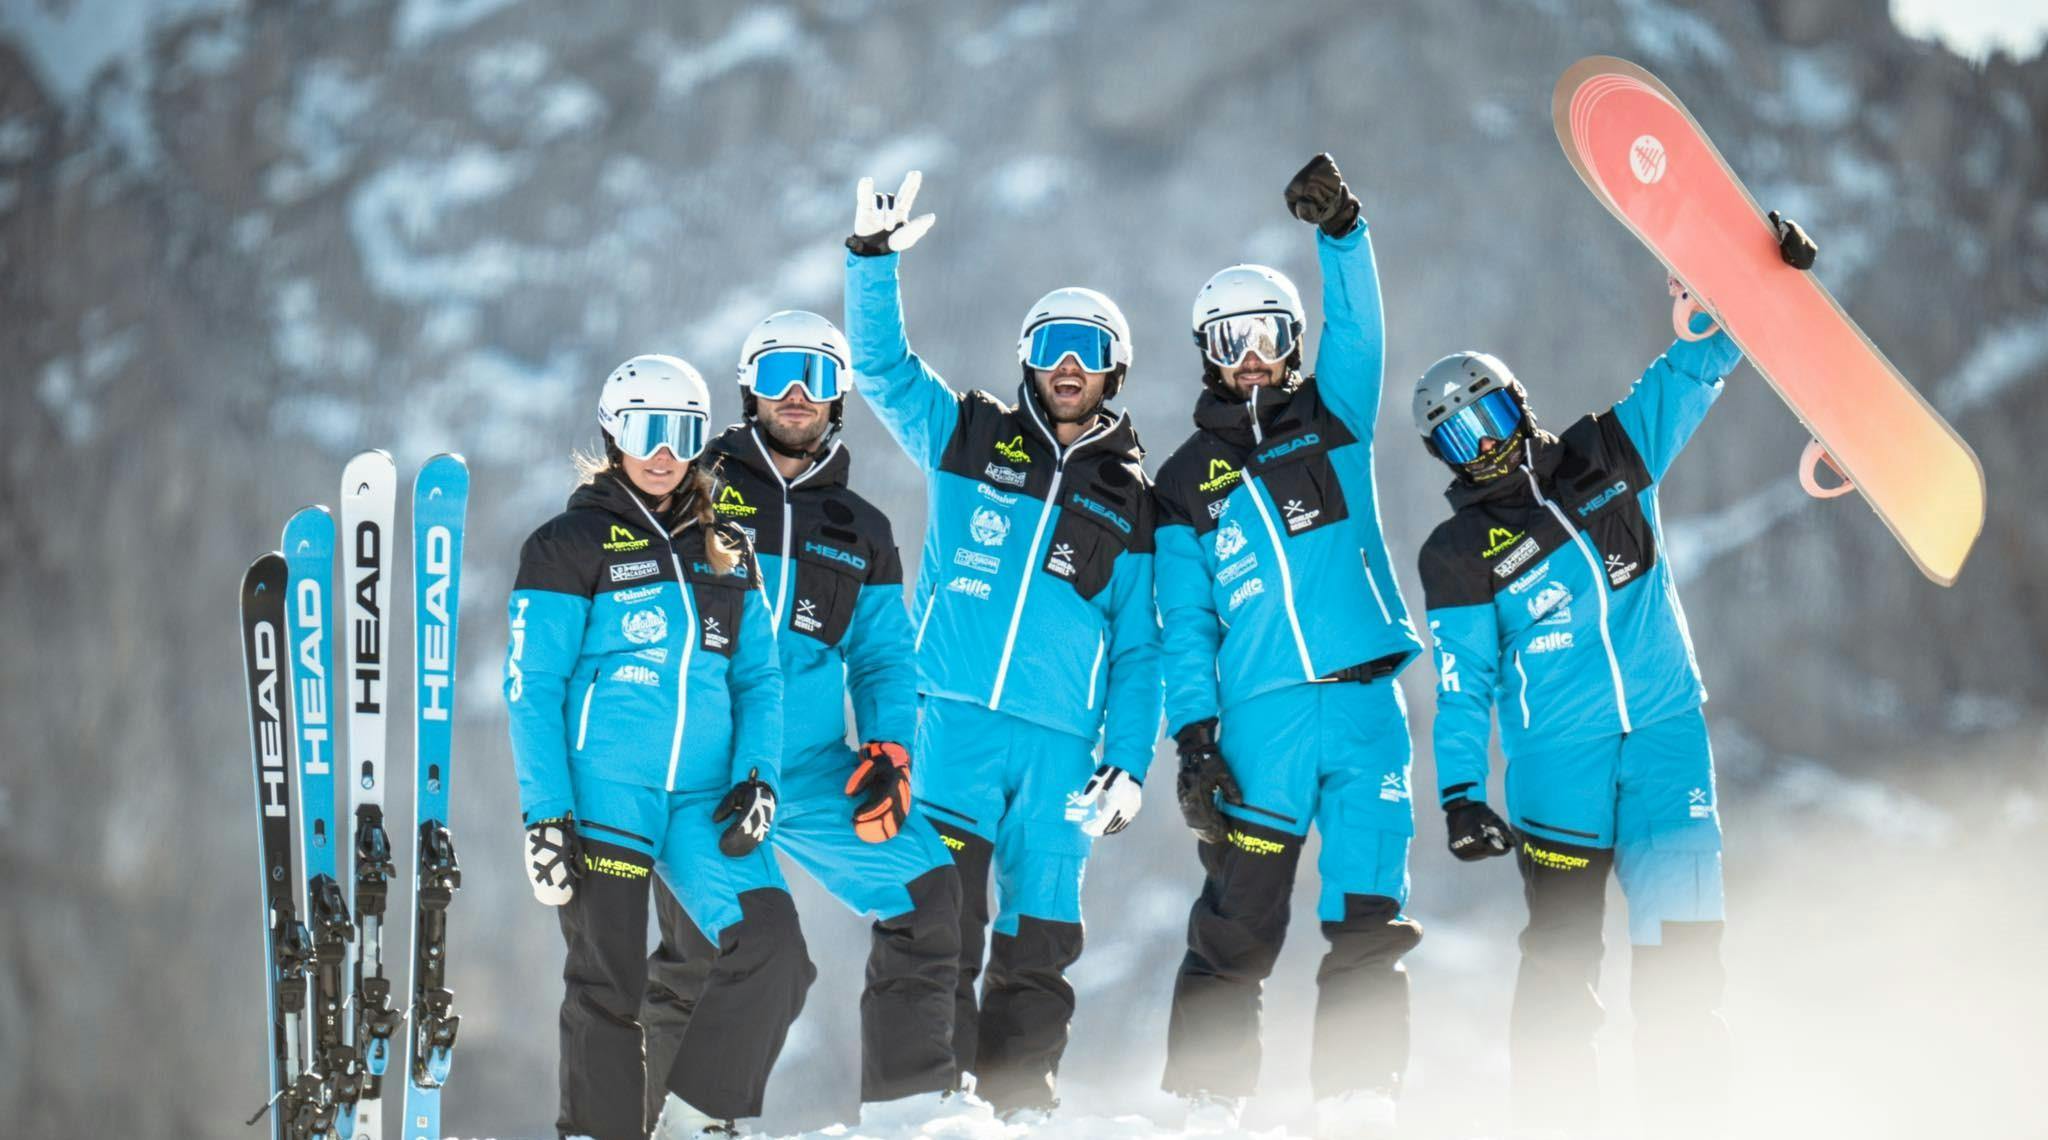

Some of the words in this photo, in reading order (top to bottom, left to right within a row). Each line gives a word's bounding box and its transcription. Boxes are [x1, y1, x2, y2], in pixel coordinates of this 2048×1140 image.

[1257, 433, 1320, 463] HEAD
[1073, 493, 1132, 533] HEAD
[1578, 480, 1628, 517] HEAD
[692, 561, 748, 579] HD
[804, 540, 867, 571] HEAD
[355, 520, 380, 714] HEAD
[423, 525, 451, 721] HEAD
[297, 577, 330, 774] HEAD
[254, 620, 287, 817] HEAD
[597, 867, 637, 880] ACADEMY
[599, 857, 649, 877] M-SPORT
[1535, 849, 1590, 868] M-SPORT
